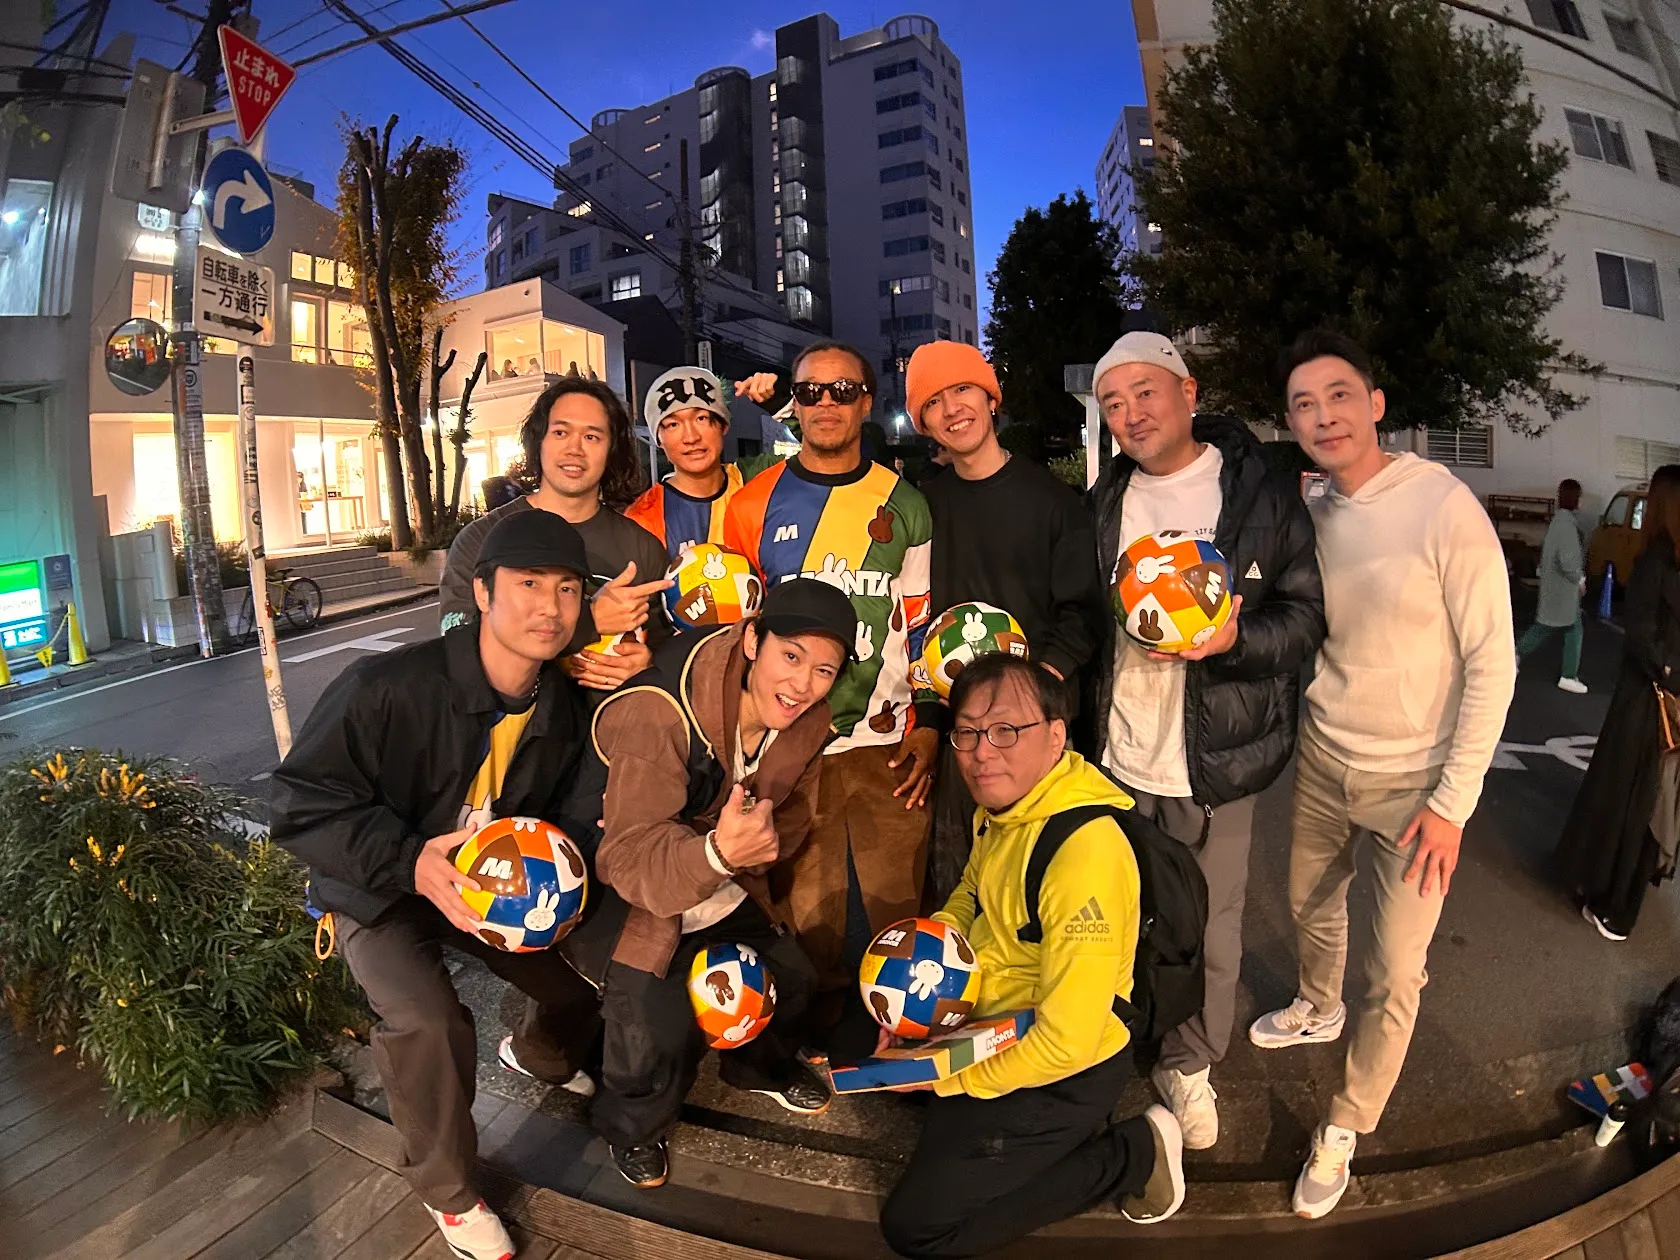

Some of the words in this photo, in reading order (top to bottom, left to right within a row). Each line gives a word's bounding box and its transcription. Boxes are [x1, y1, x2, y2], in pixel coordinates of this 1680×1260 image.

[232, 48, 280, 88] 止まれ
[238, 75, 272, 106] STOP
[203, 256, 268, 294] 自転車を除く
[201, 286, 269, 317] 一方通行
[773, 524, 799, 543] M
[781, 569, 893, 598] NTA
[478, 857, 512, 880] M
[1064, 920, 1110, 934] adidas
[985, 1027, 1016, 1050] MONTA
